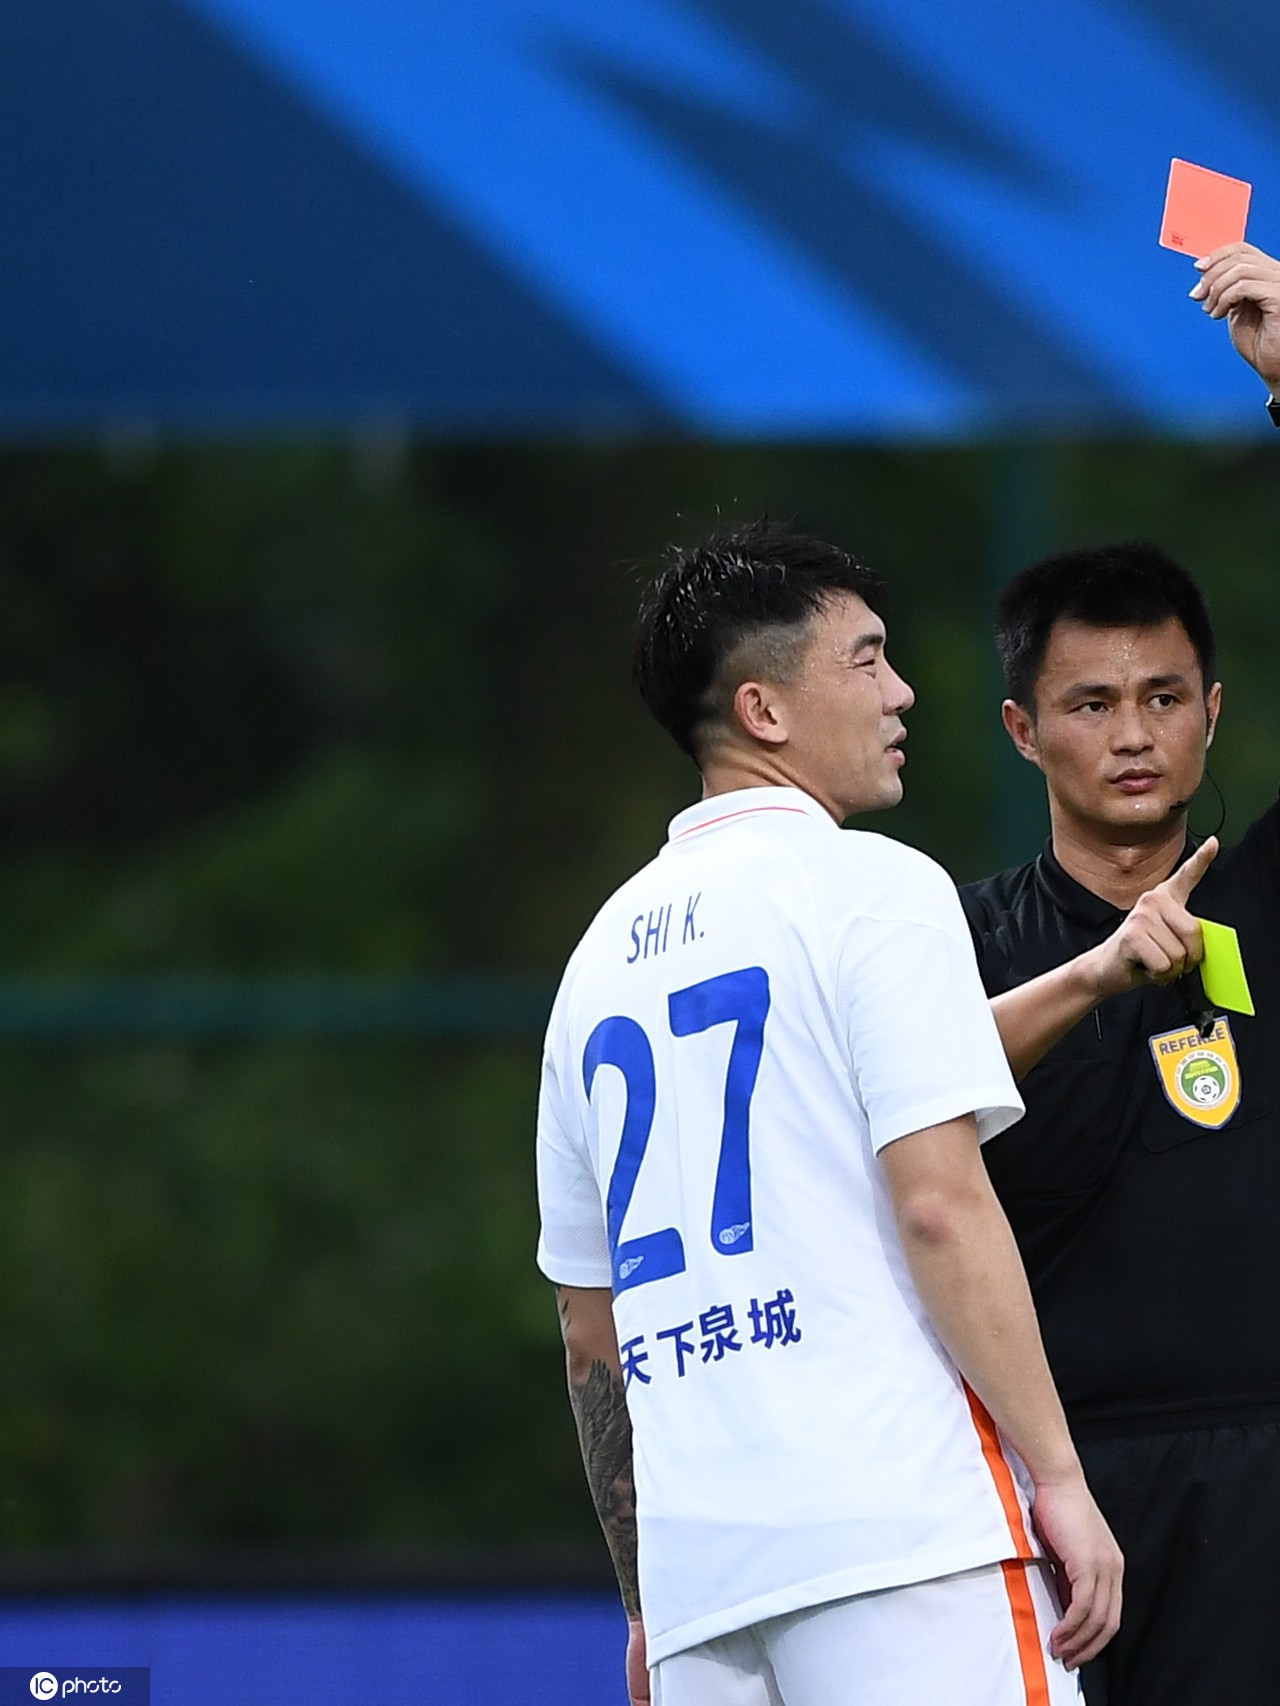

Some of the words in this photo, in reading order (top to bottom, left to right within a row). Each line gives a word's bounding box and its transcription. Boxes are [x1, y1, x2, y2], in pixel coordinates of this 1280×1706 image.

[627, 904, 672, 964] SHI
[682, 892, 705, 945] K.
[582, 966, 771, 1296] 27
[621, 1288, 802, 1388] 天下泉城
